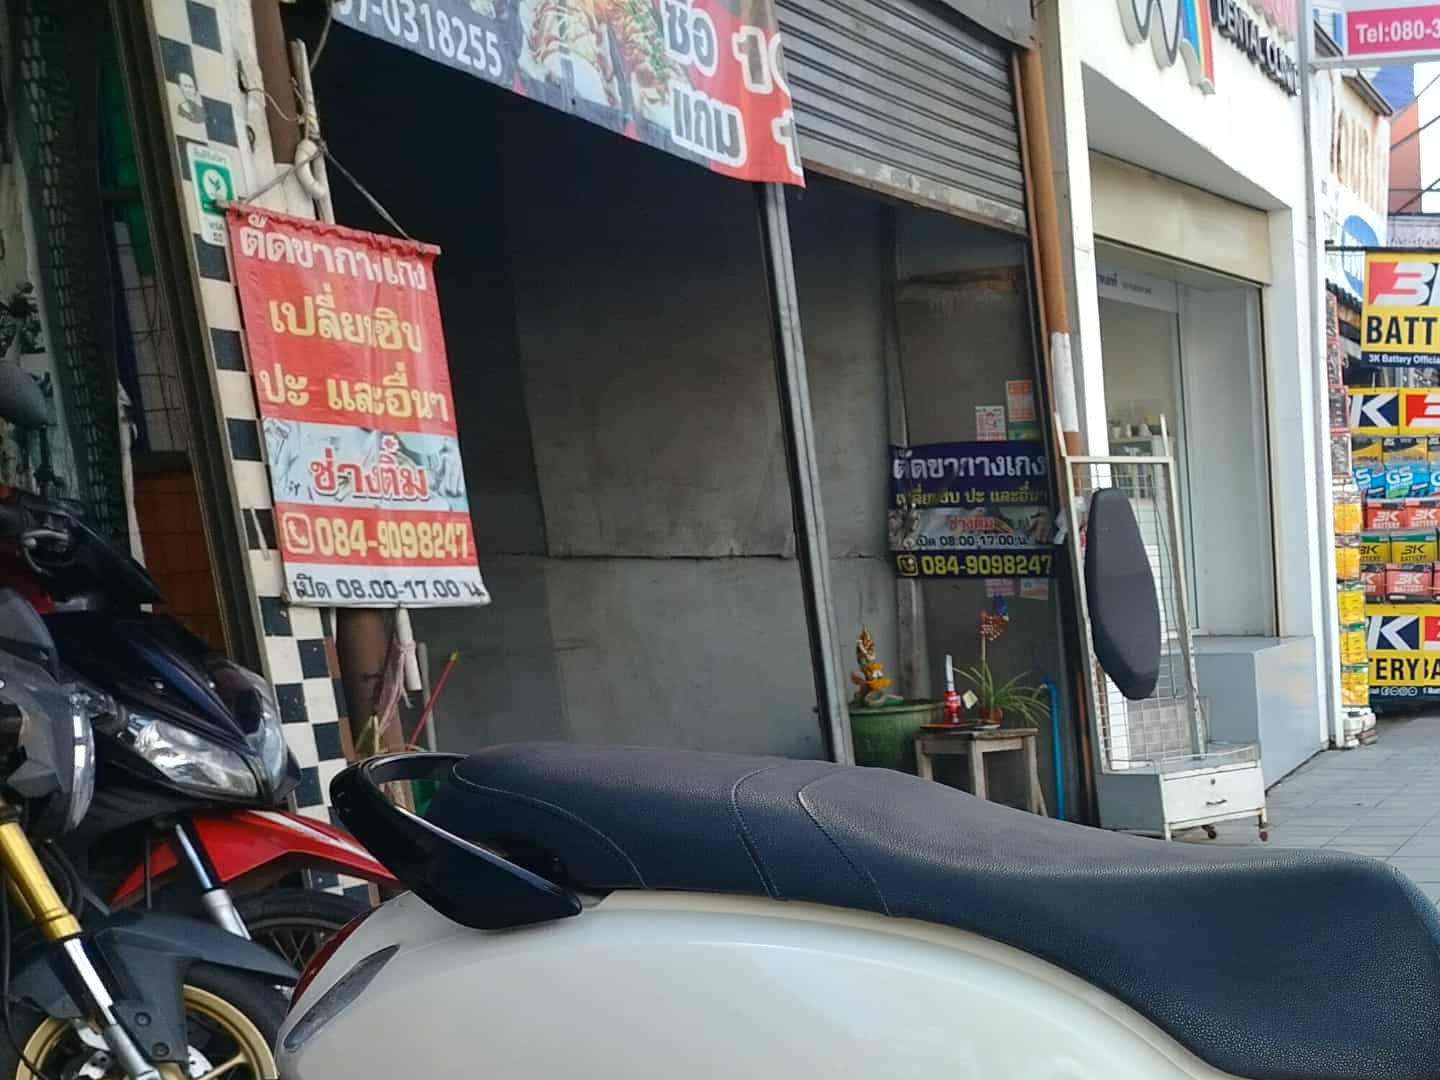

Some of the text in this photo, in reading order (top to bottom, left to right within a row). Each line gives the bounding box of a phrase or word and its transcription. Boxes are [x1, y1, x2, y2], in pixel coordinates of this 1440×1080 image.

[1368, 354, 1381, 363] 3K
[1382, 354, 1411, 366] Battery
[260, 363, 310, 407] ปะ
[314, 517, 470, 559] 084-9098247
[921, 554, 1052, 576] 084-9098247
[335, 578, 461, 601] 08.00-17.00
